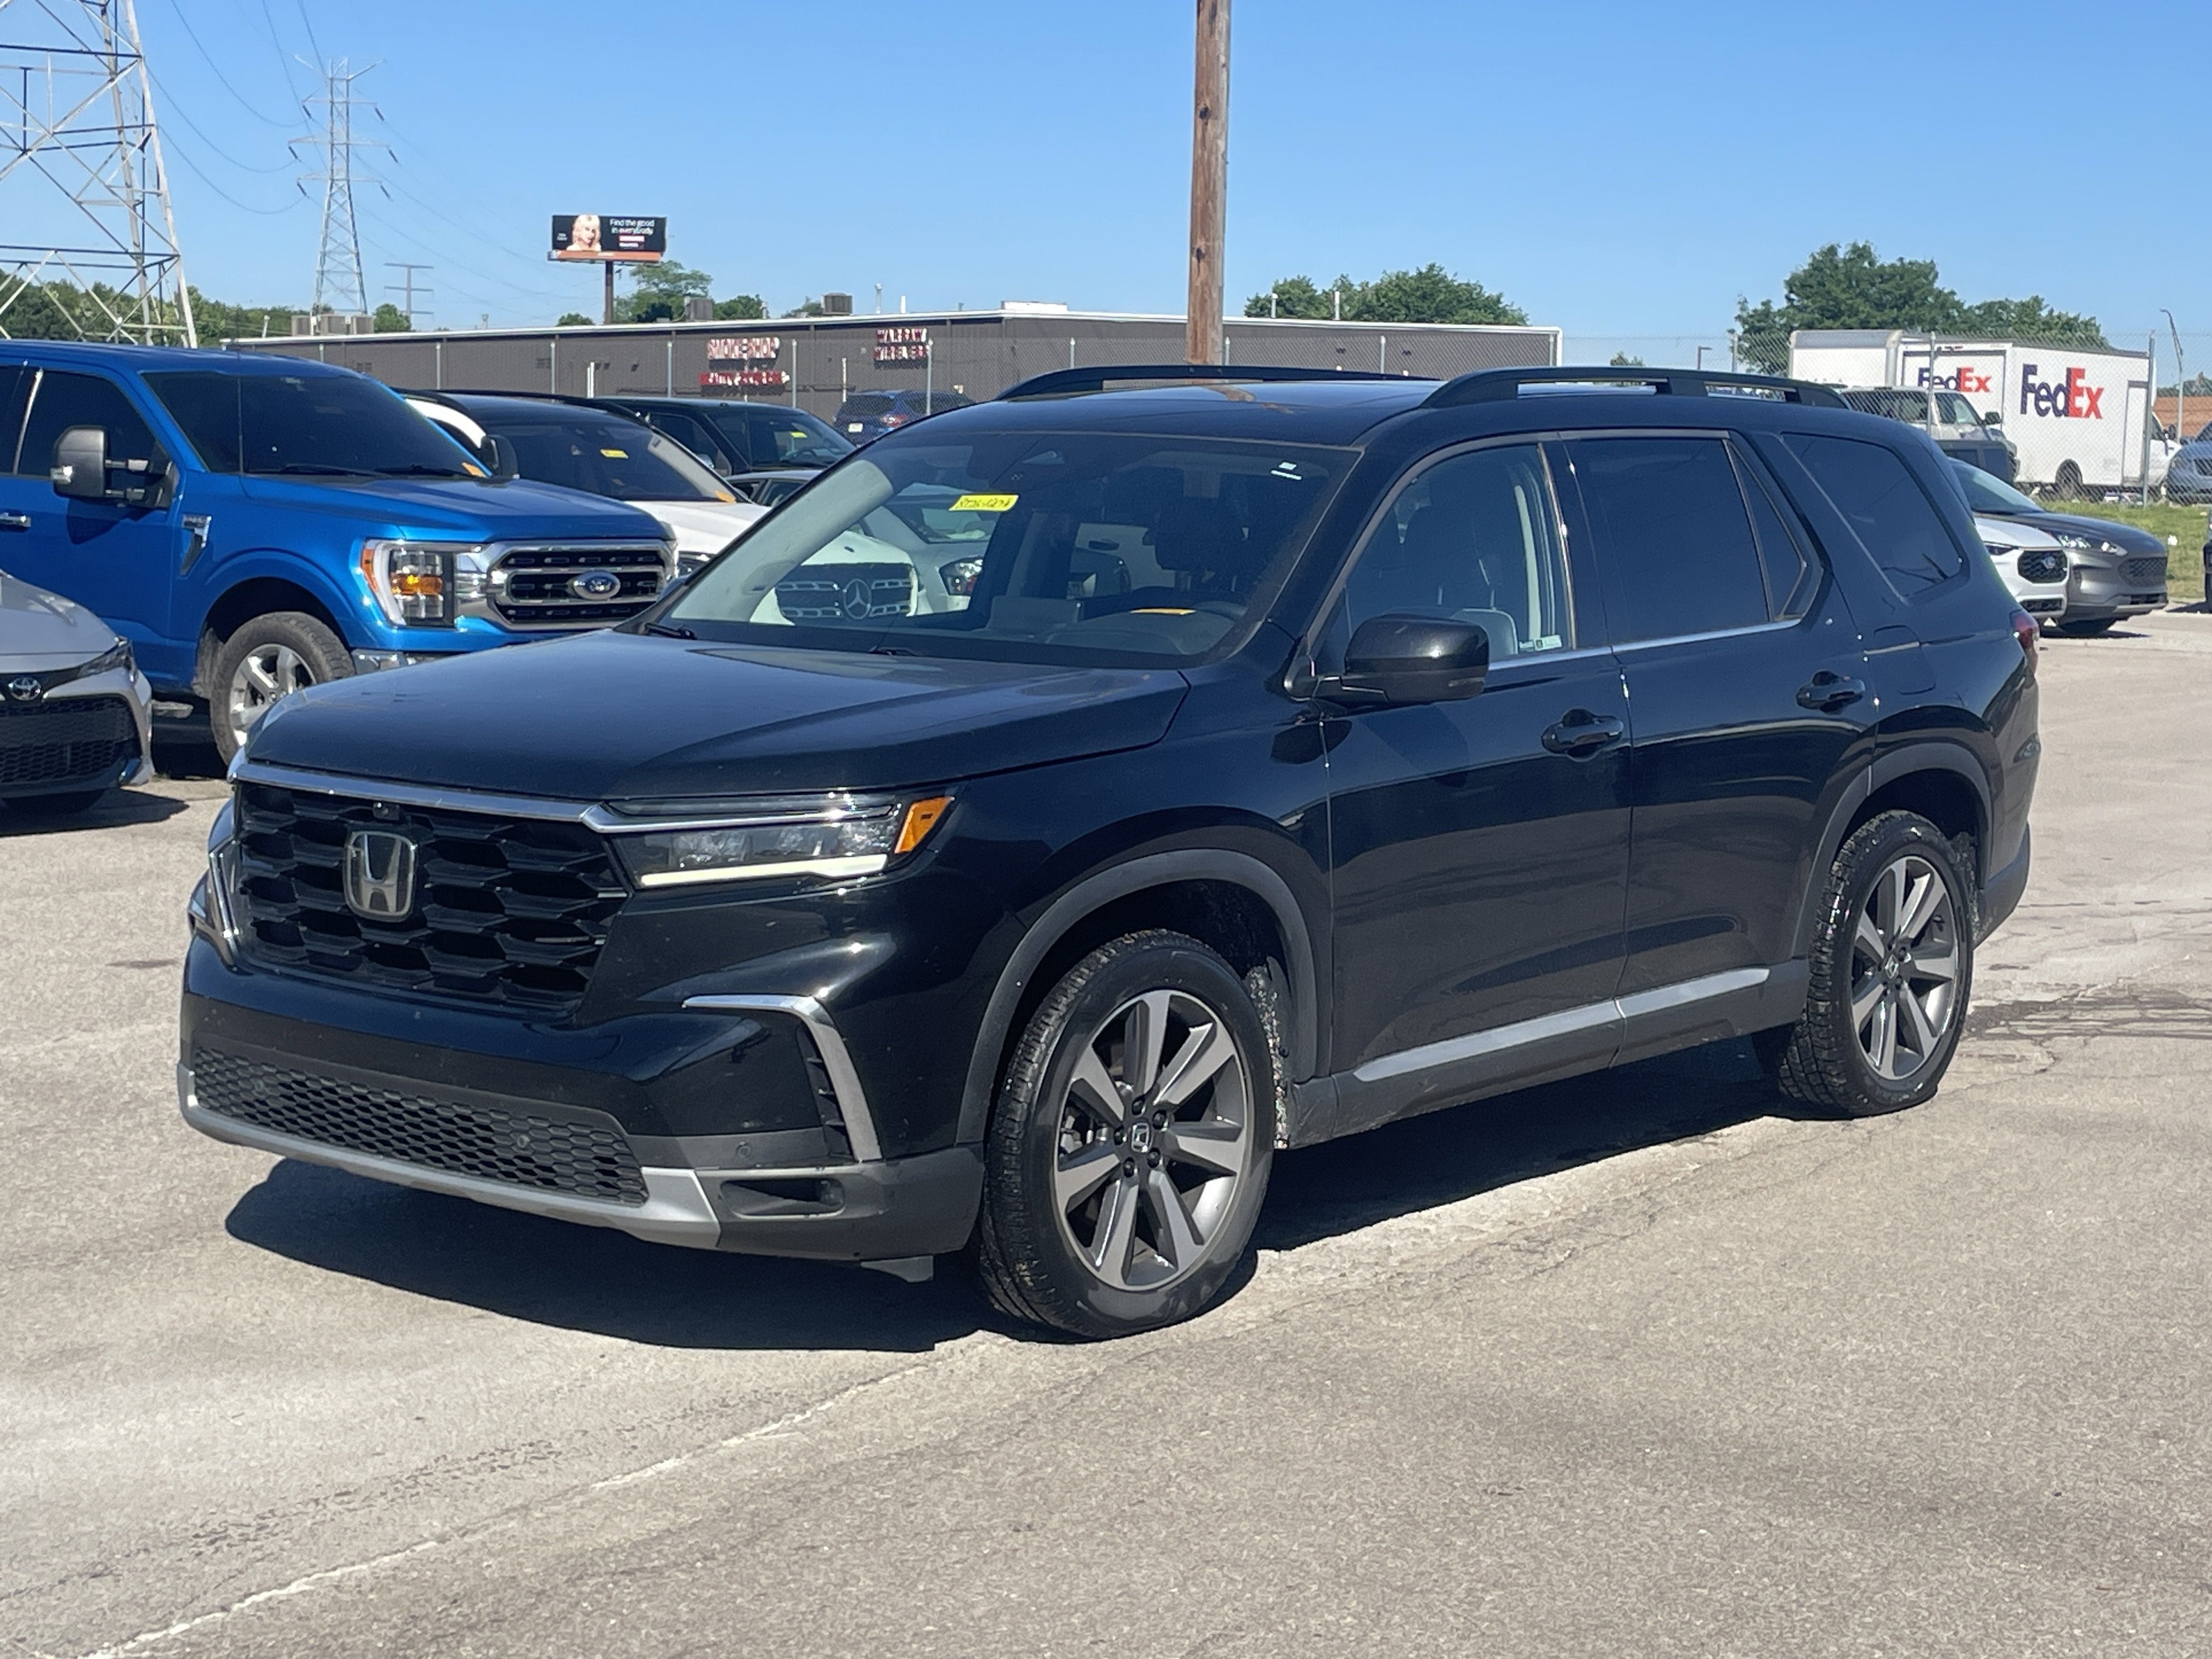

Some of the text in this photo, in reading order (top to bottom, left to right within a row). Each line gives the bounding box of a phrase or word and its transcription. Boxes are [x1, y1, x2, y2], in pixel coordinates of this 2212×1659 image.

[637, 219, 654, 228] good
[1917, 367, 1992, 393] FedEx
[2021, 363, 2104, 419] FedEx
